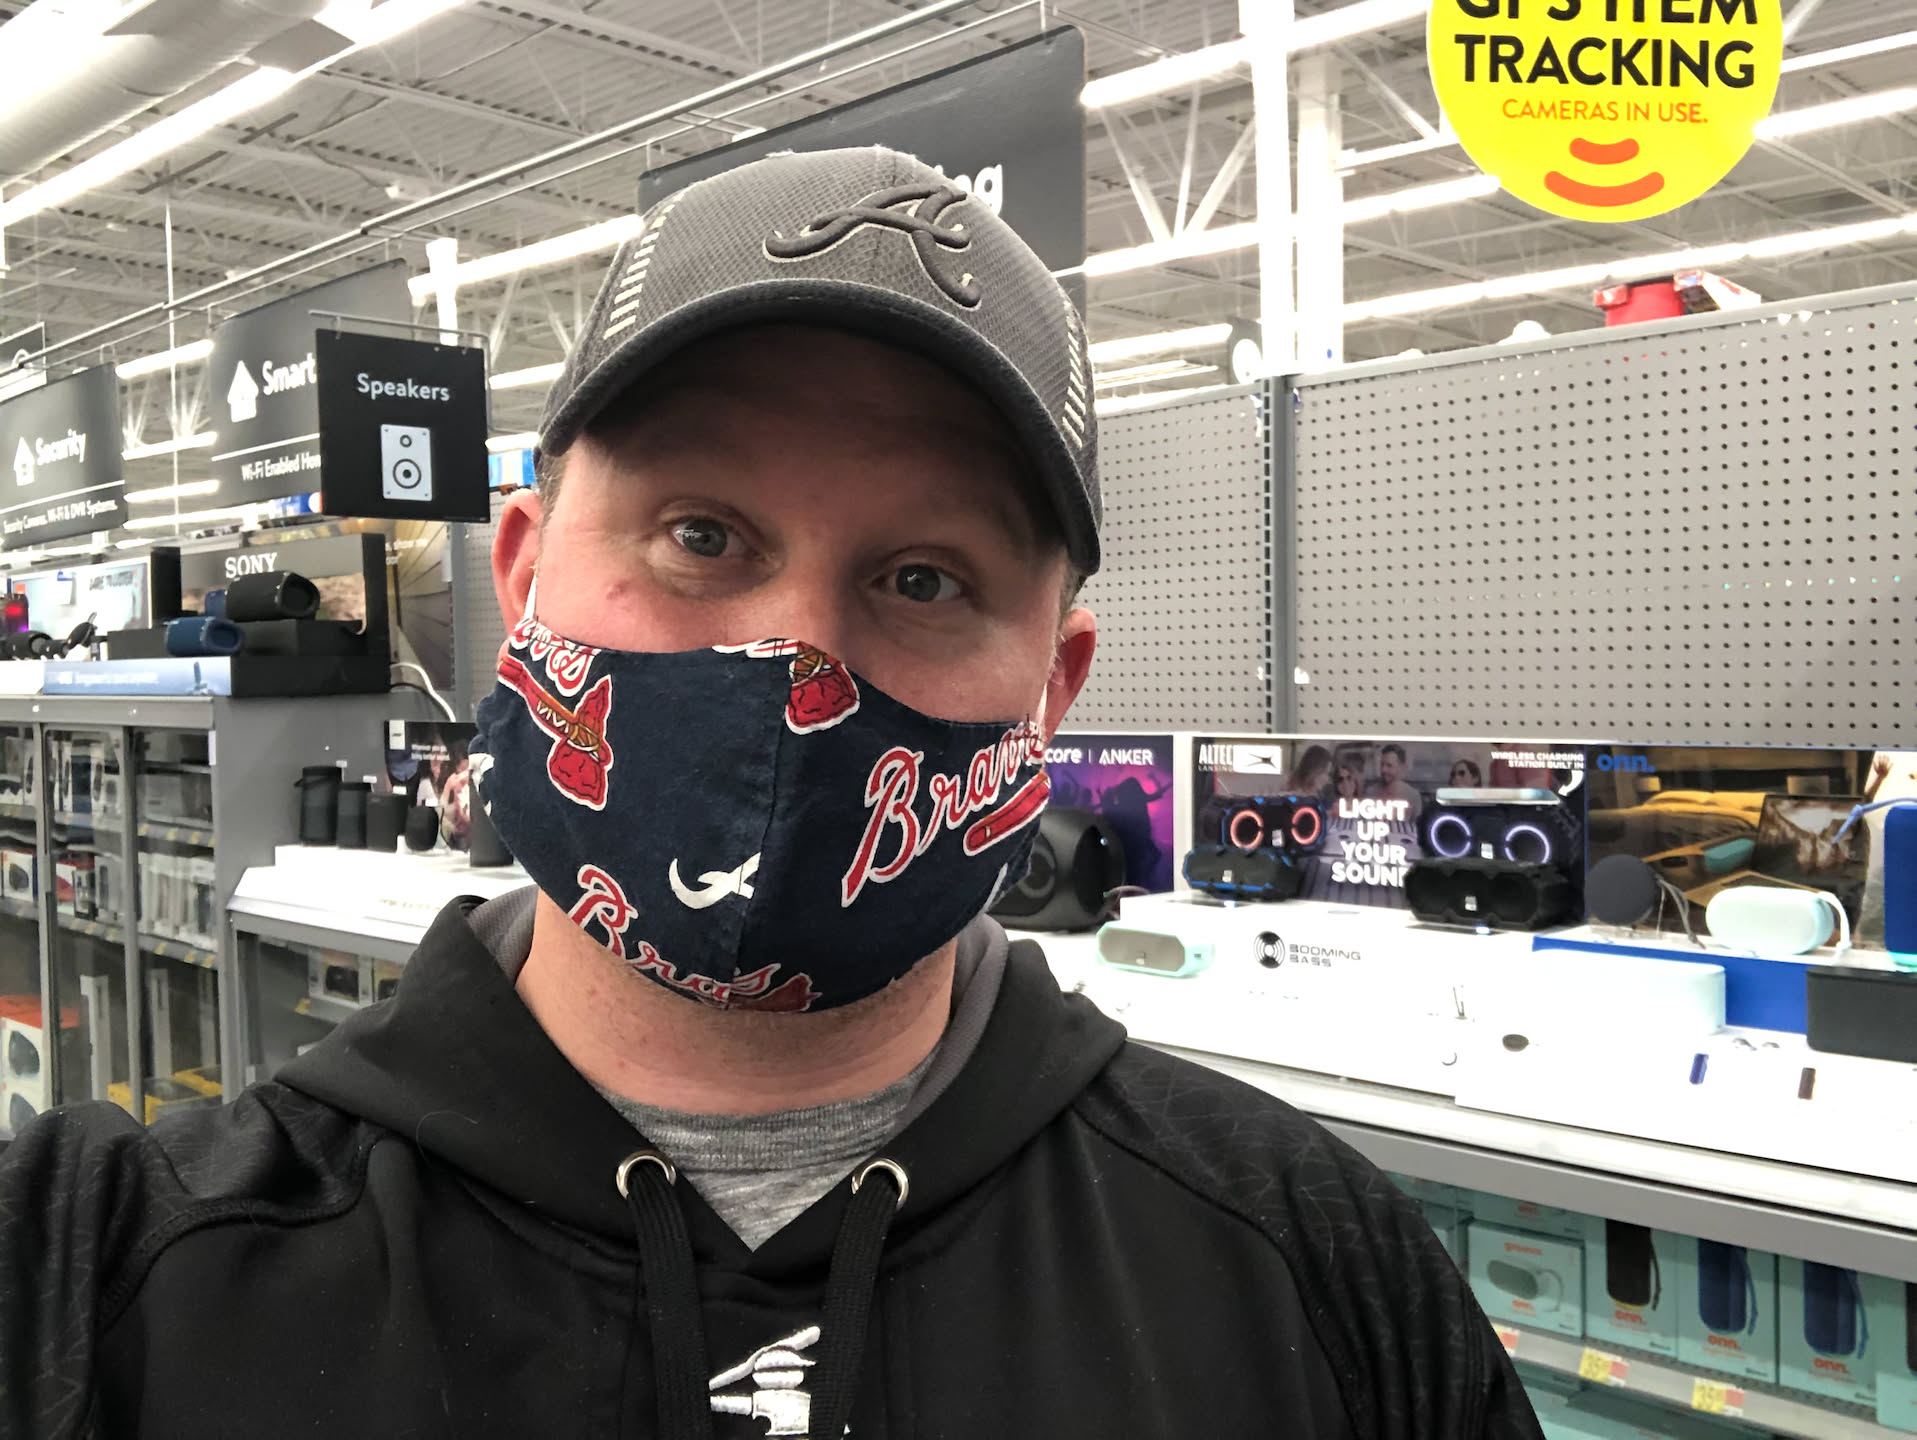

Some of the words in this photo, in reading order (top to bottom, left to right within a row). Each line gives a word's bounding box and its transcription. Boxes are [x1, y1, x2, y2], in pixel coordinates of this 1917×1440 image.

[1454, 34, 1755, 88] TRACKING
[1502, 98, 1619, 121] CAMERAS
[1626, 103, 1651, 121] IN
[1658, 102, 1708, 123] USE.
[262, 352, 317, 395] Smart
[357, 372, 450, 402] Speakers
[35, 428, 87, 466] Security
[225, 552, 277, 579] SONY
[1099, 748, 1154, 766] ANKER
[1490, 751, 1535, 761] WIRELESS
[1536, 752, 1584, 762] CHARGING
[1508, 760, 1546, 769] STATION
[1596, 754, 1656, 772] onn.
[1339, 797, 1409, 821] LIGHT
[1357, 820, 1390, 842] UP
[1340, 841, 1406, 866] YOUR
[1289, 943, 1361, 961] BOOMING
[1289, 953, 1331, 967] BASS
